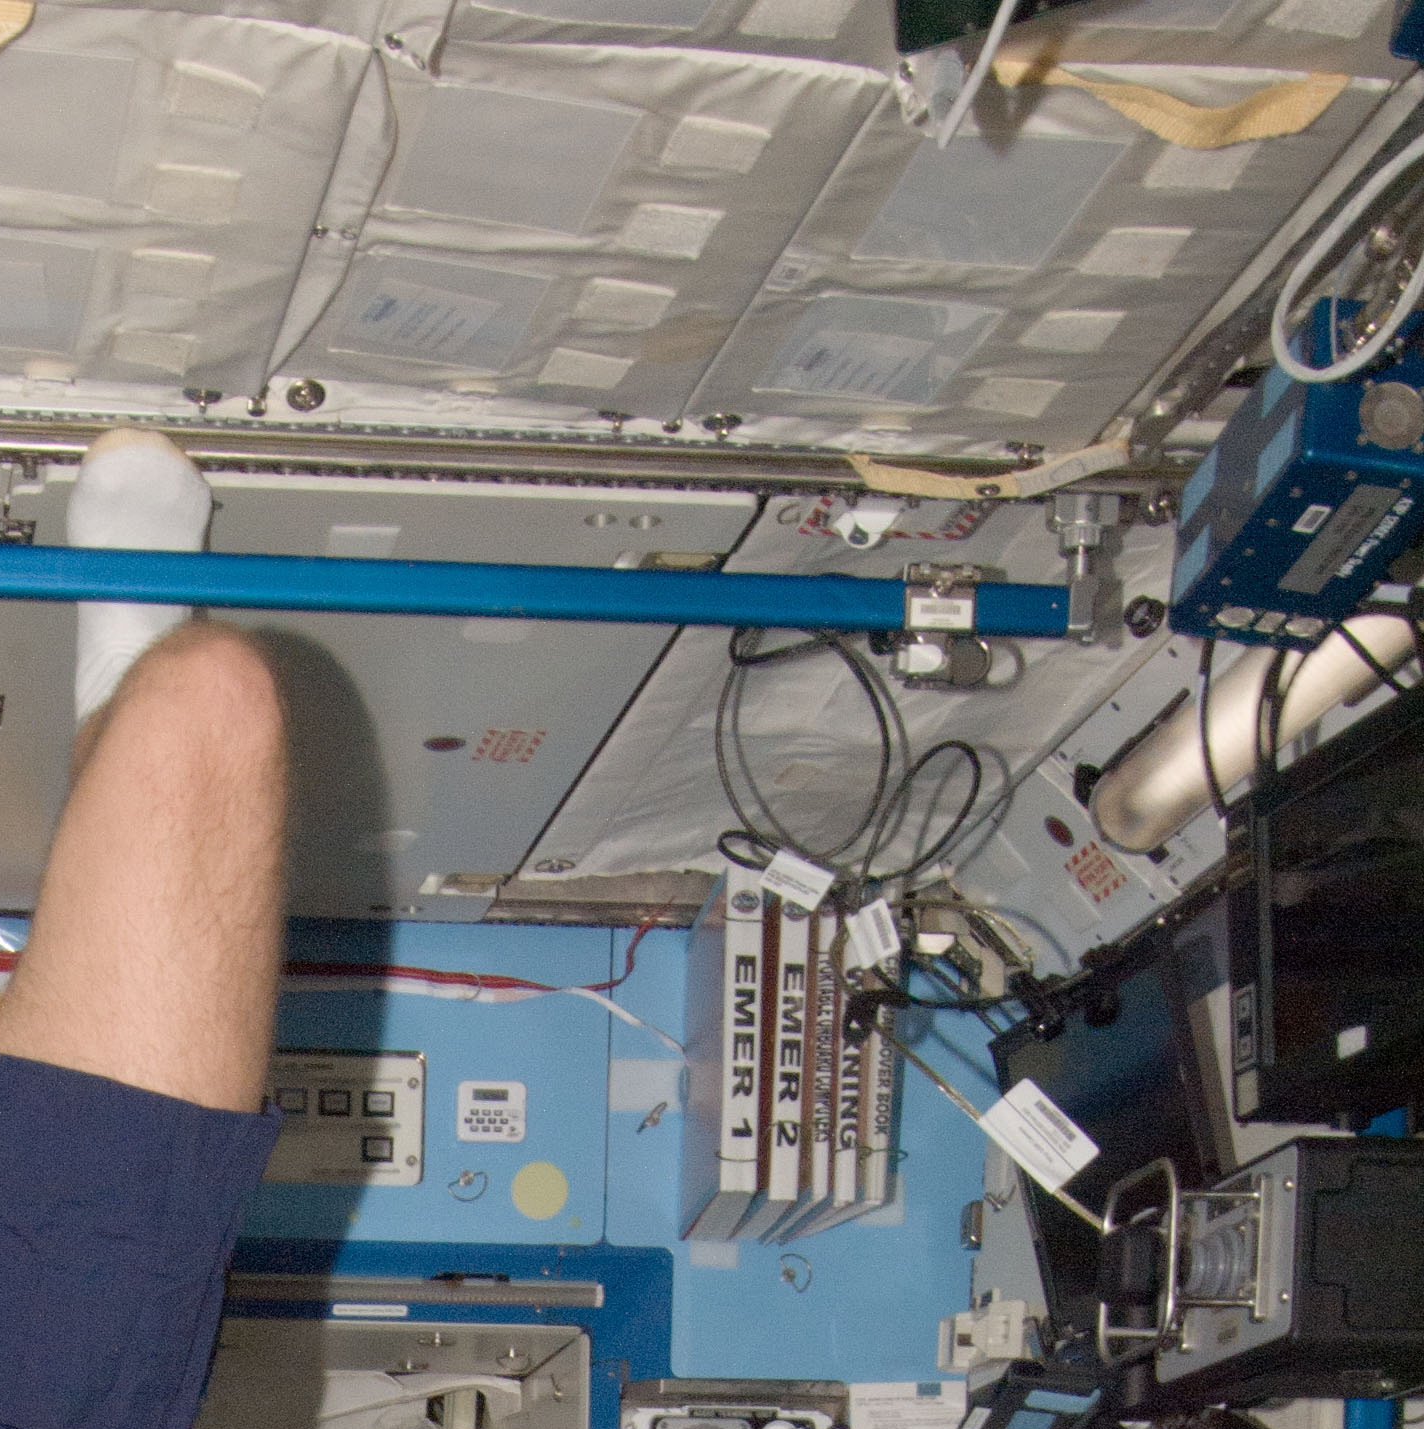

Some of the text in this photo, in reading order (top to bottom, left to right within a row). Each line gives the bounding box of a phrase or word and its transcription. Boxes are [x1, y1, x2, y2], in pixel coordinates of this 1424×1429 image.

[730, 954, 757, 1139] EMER 1
[776, 962, 805, 1148] EMER 2
[875, 1093, 890, 1136] BOOK
